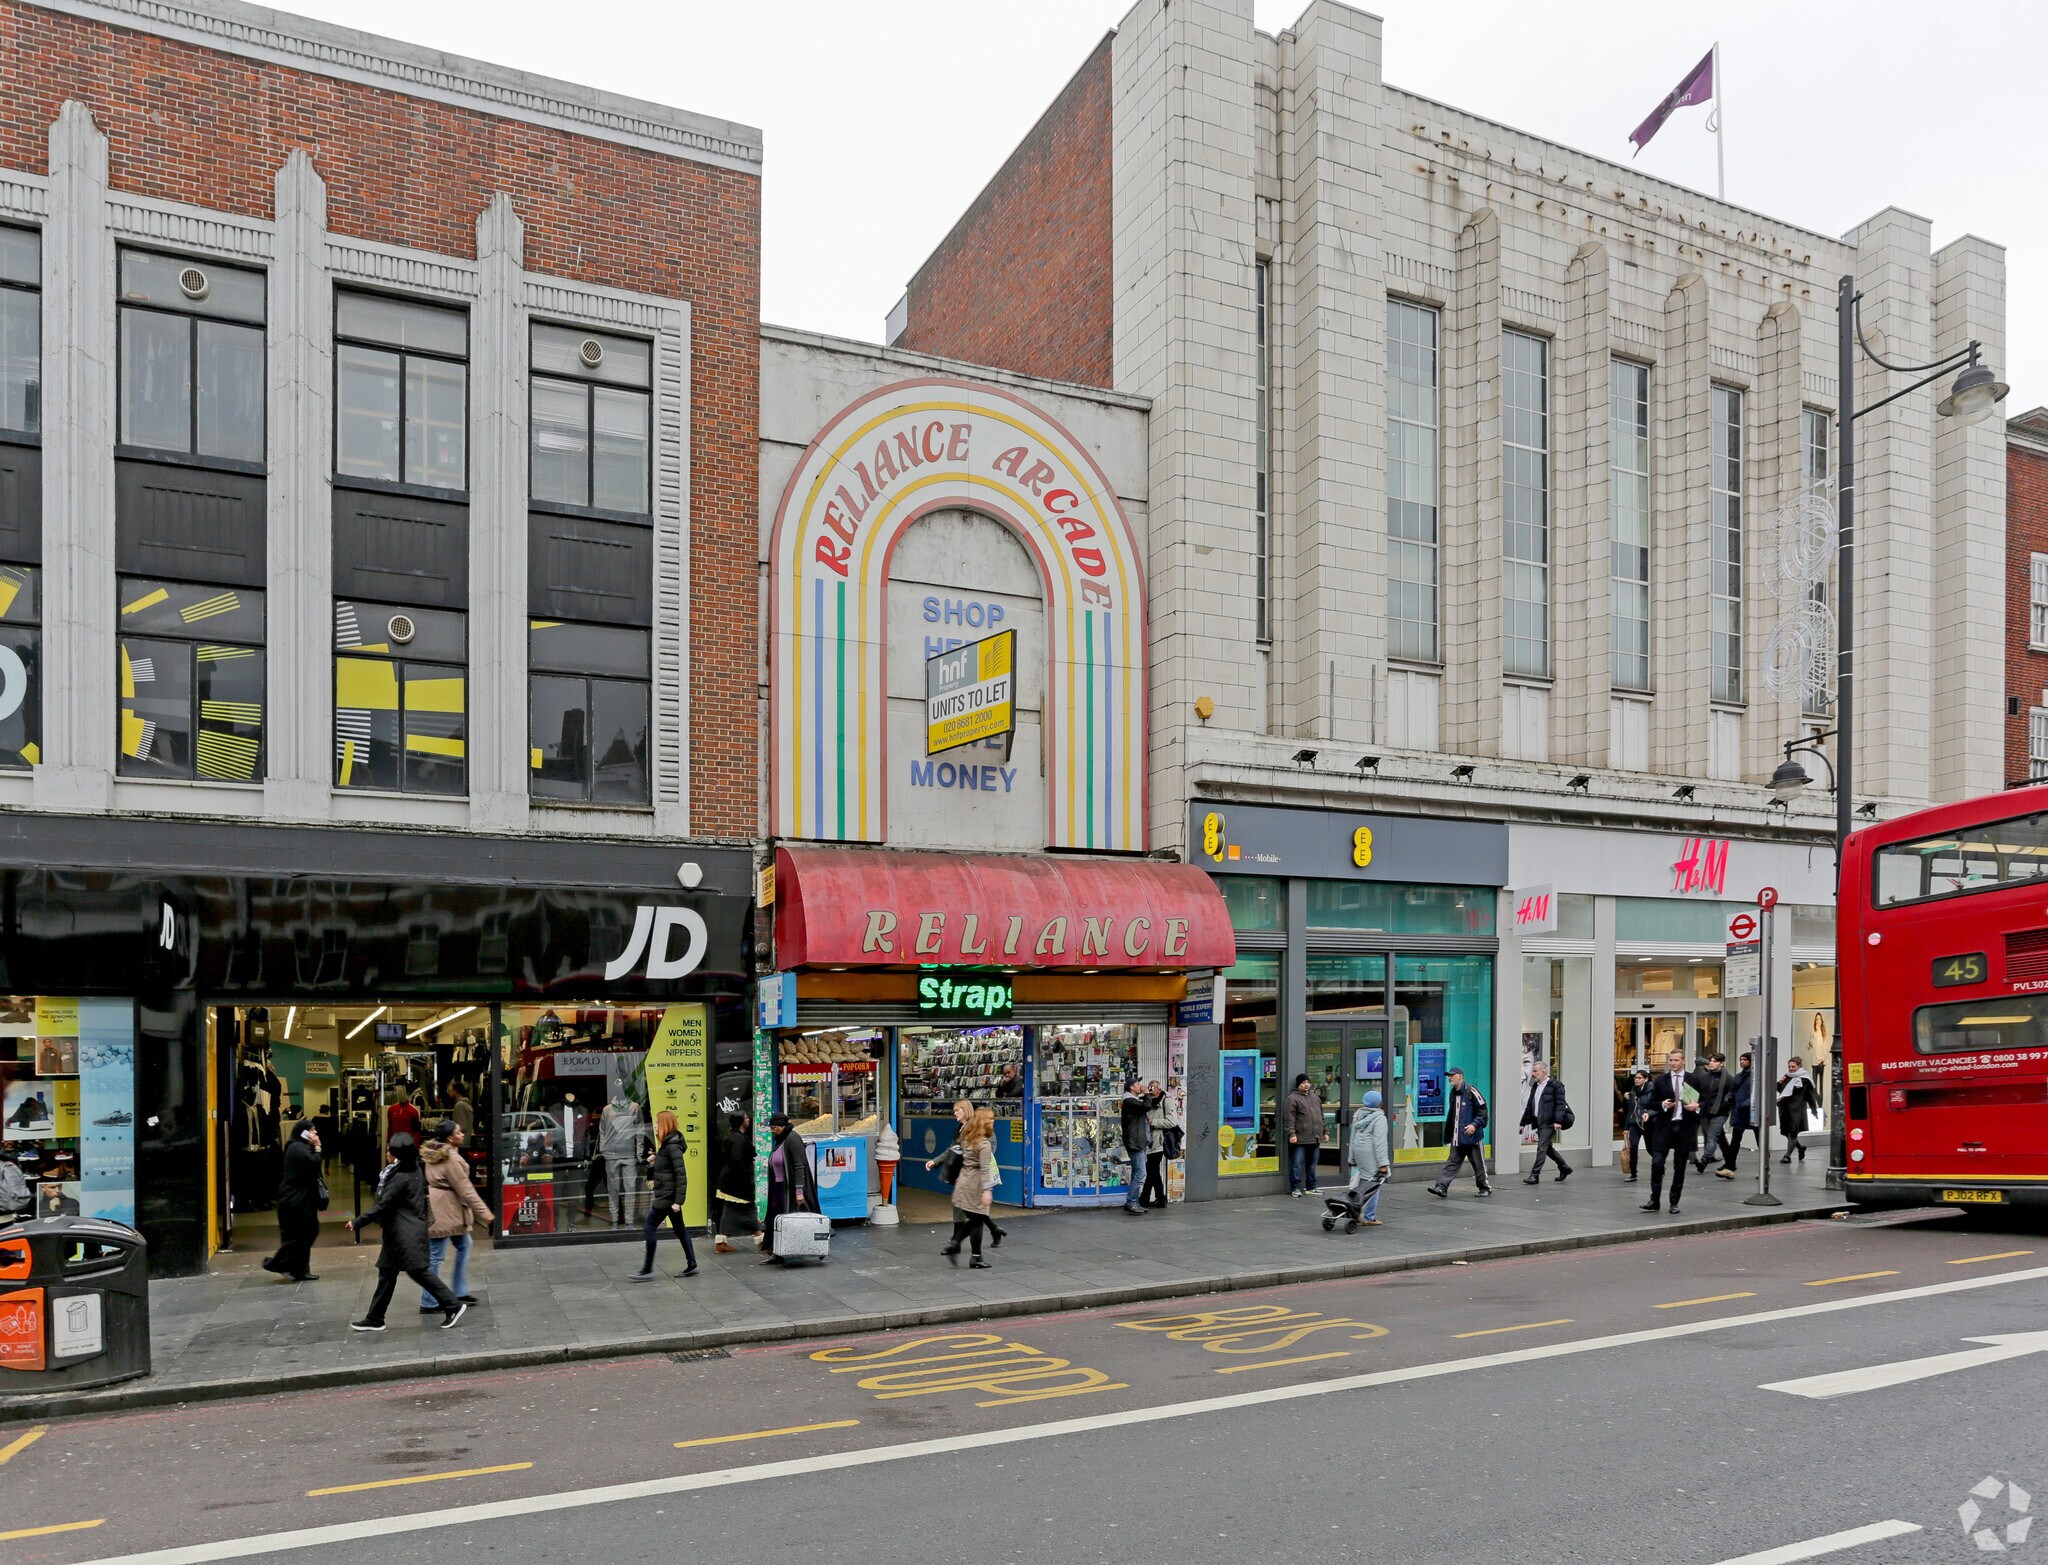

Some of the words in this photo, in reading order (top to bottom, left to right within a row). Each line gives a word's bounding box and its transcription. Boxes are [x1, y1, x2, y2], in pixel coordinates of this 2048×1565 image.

[816, 420, 972, 577] RELIANCE
[992, 446, 1112, 609] ARCADE
[923, 596, 1005, 628] SHOP
[939, 650, 967, 684] hnf
[932, 694, 965, 720] UNITS
[968, 689, 983, 709] TO
[986, 681, 1007, 704] LET
[939, 681, 959, 692] Property
[933, 720, 1005, 747] www.hnfproperty.com
[944, 722, 956, 733] 020
[957, 715, 973, 731] 8681
[975, 710, 992, 725] 2000
[911, 760, 1018, 793] MONEY
[1673, 838, 1730, 895] H&M
[1517, 893, 1550, 925] H&M
[1761, 890, 1773, 906] P
[160, 902, 175, 950] JD
[862, 910, 1190, 958] RELIANCE
[605, 905, 708, 980] JD
[1944, 956, 1980, 980] 45
[668, 1029, 702, 1037] WOMEN
[670, 1039, 702, 1047] JUNIOR
[843, 1062, 870, 1071] POPCORN
[1882, 1062, 1897, 1070] BUS
[1899, 1059, 1927, 1069] DRIVER
[1929, 1056, 1977, 1067] VACANCIES
[1993, 1053, 2015, 1062] 0800
[2016, 1052, 2028, 1061] 38
[2029, 1051, 2041, 1060] 99
[1919, 1061, 2018, 1073] www.go-ahead-london.com
[1947, 1191, 1974, 1201] PJ02
[1976, 1191, 1997, 1201] RFX
[1114, 1305, 1390, 1354] BUS
[808, 1333, 1109, 1400] STOP
